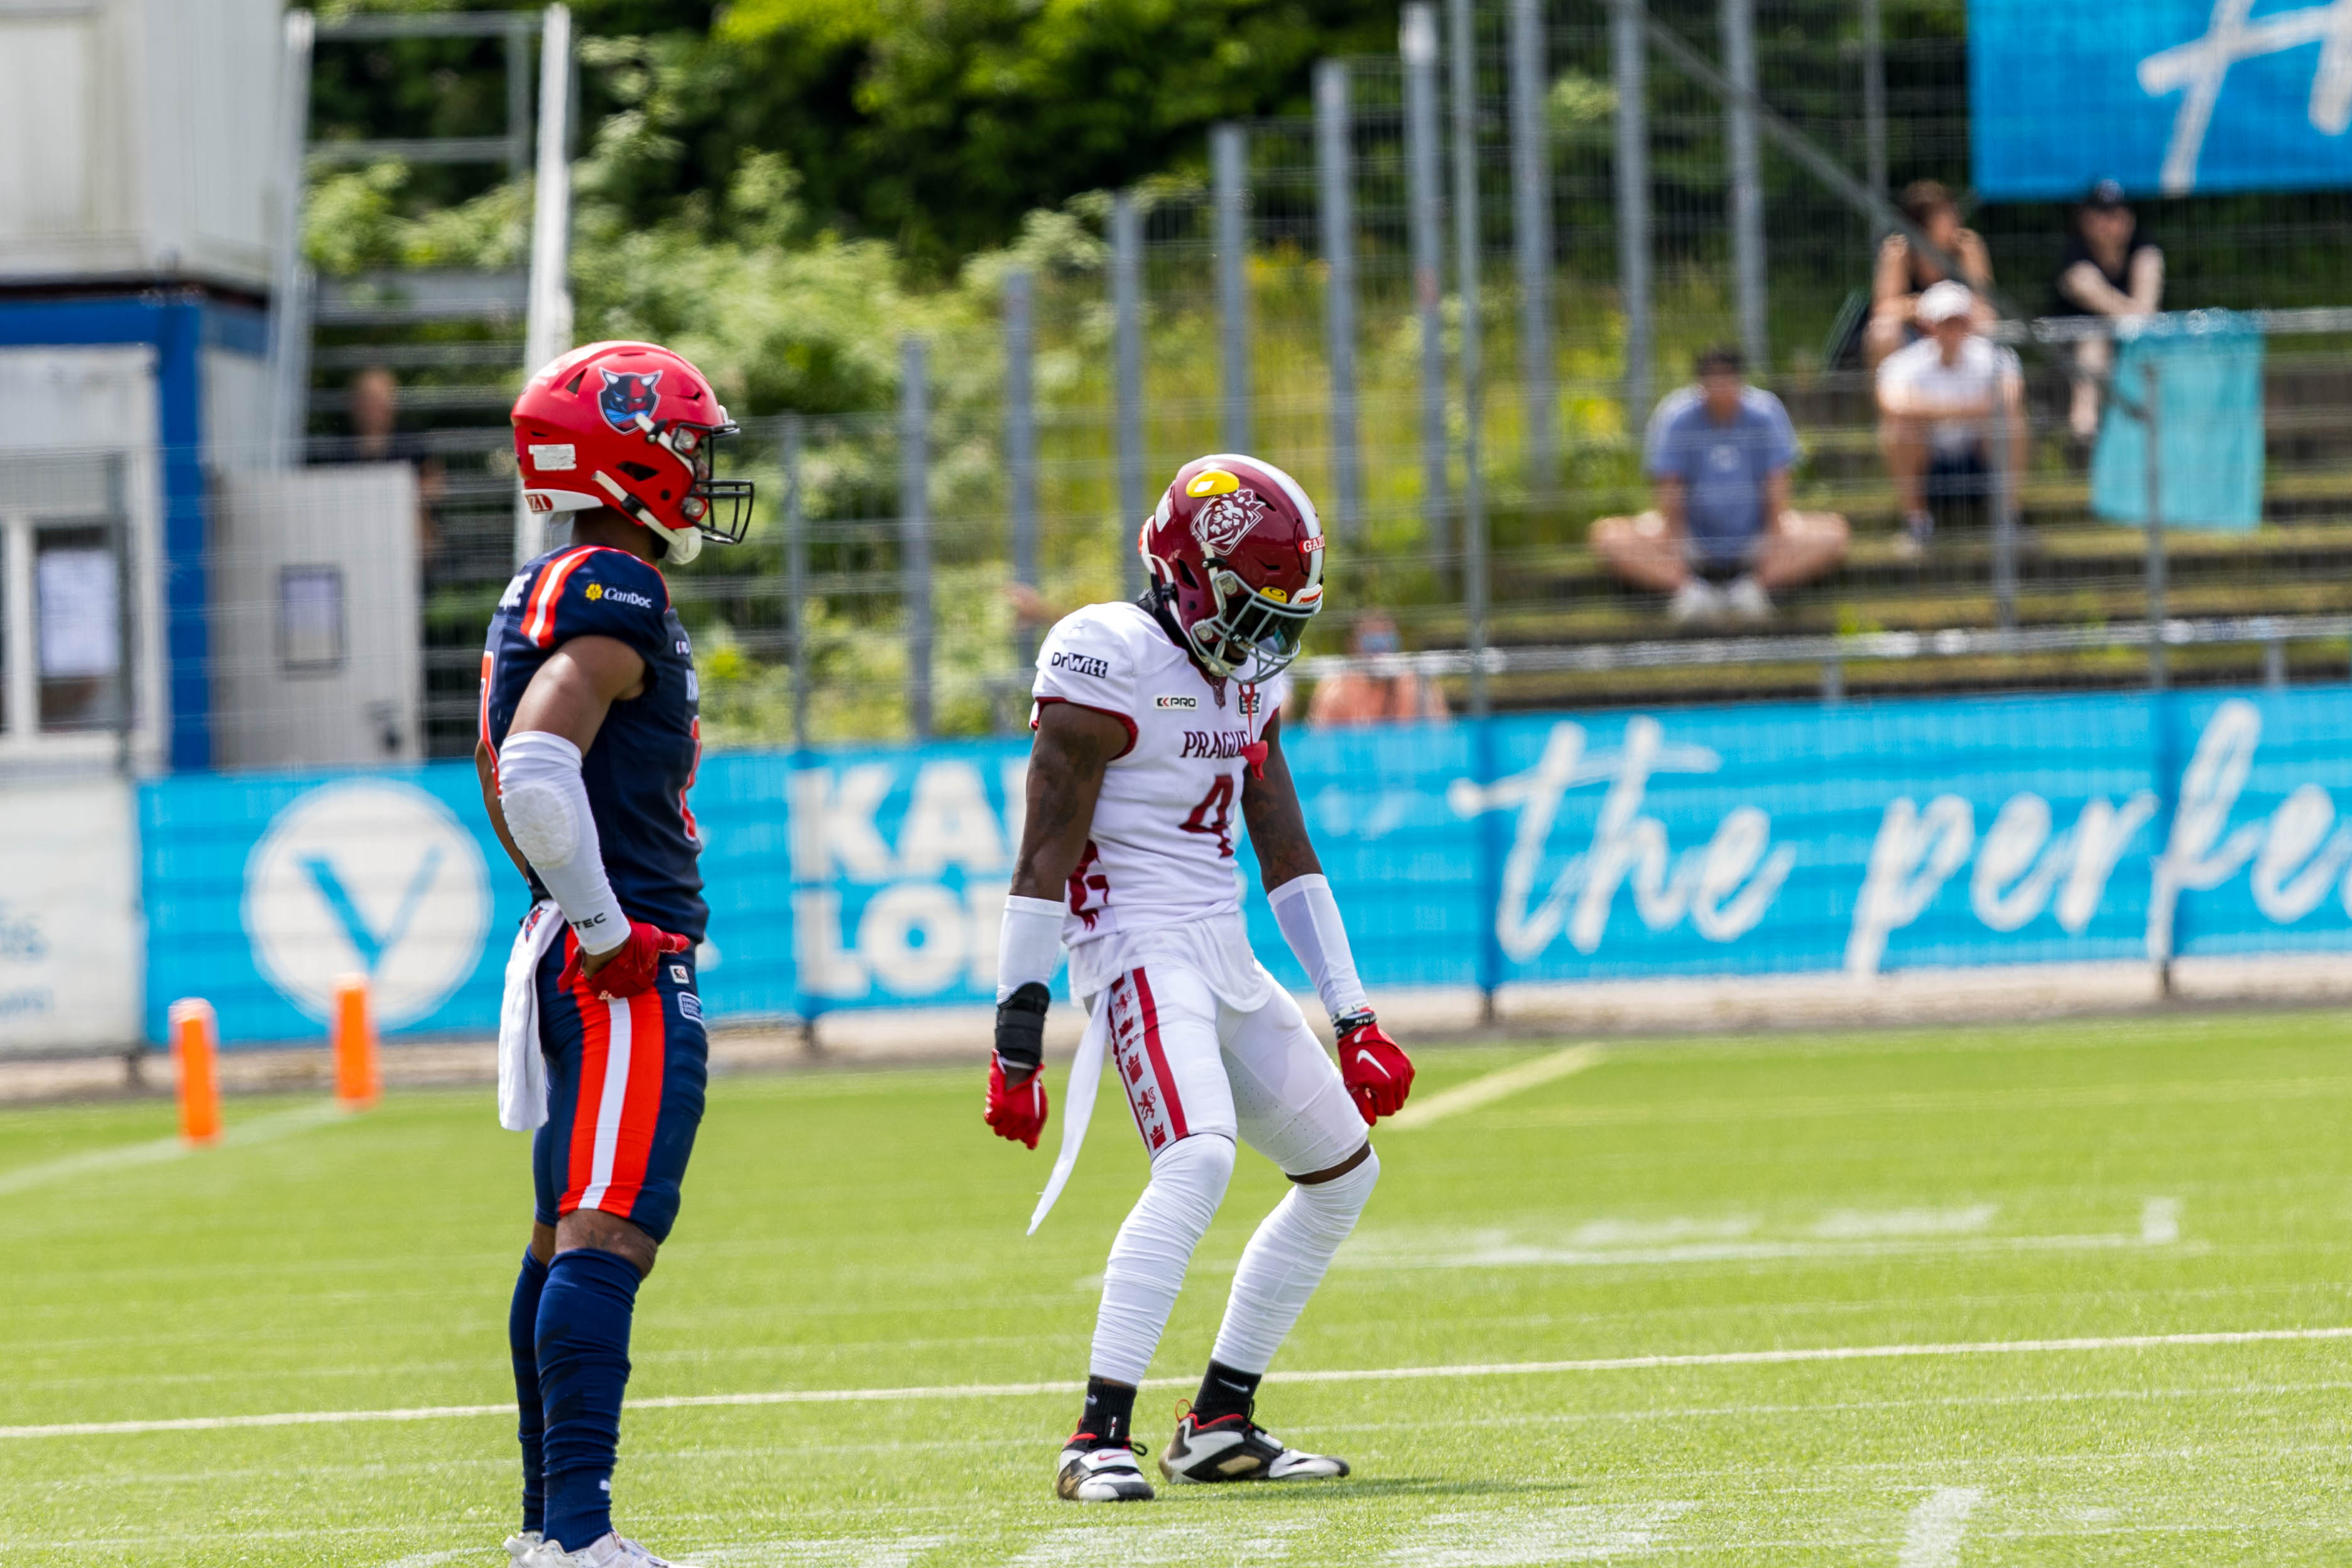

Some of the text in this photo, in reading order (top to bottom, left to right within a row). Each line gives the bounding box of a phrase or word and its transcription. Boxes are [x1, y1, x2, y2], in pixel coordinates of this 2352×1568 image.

[604, 587, 652, 609] CanDoc
[1178, 774, 1234, 859] 4
[1447, 699, 2352, 985] the perfe
[572, 912, 606, 930] TEC
